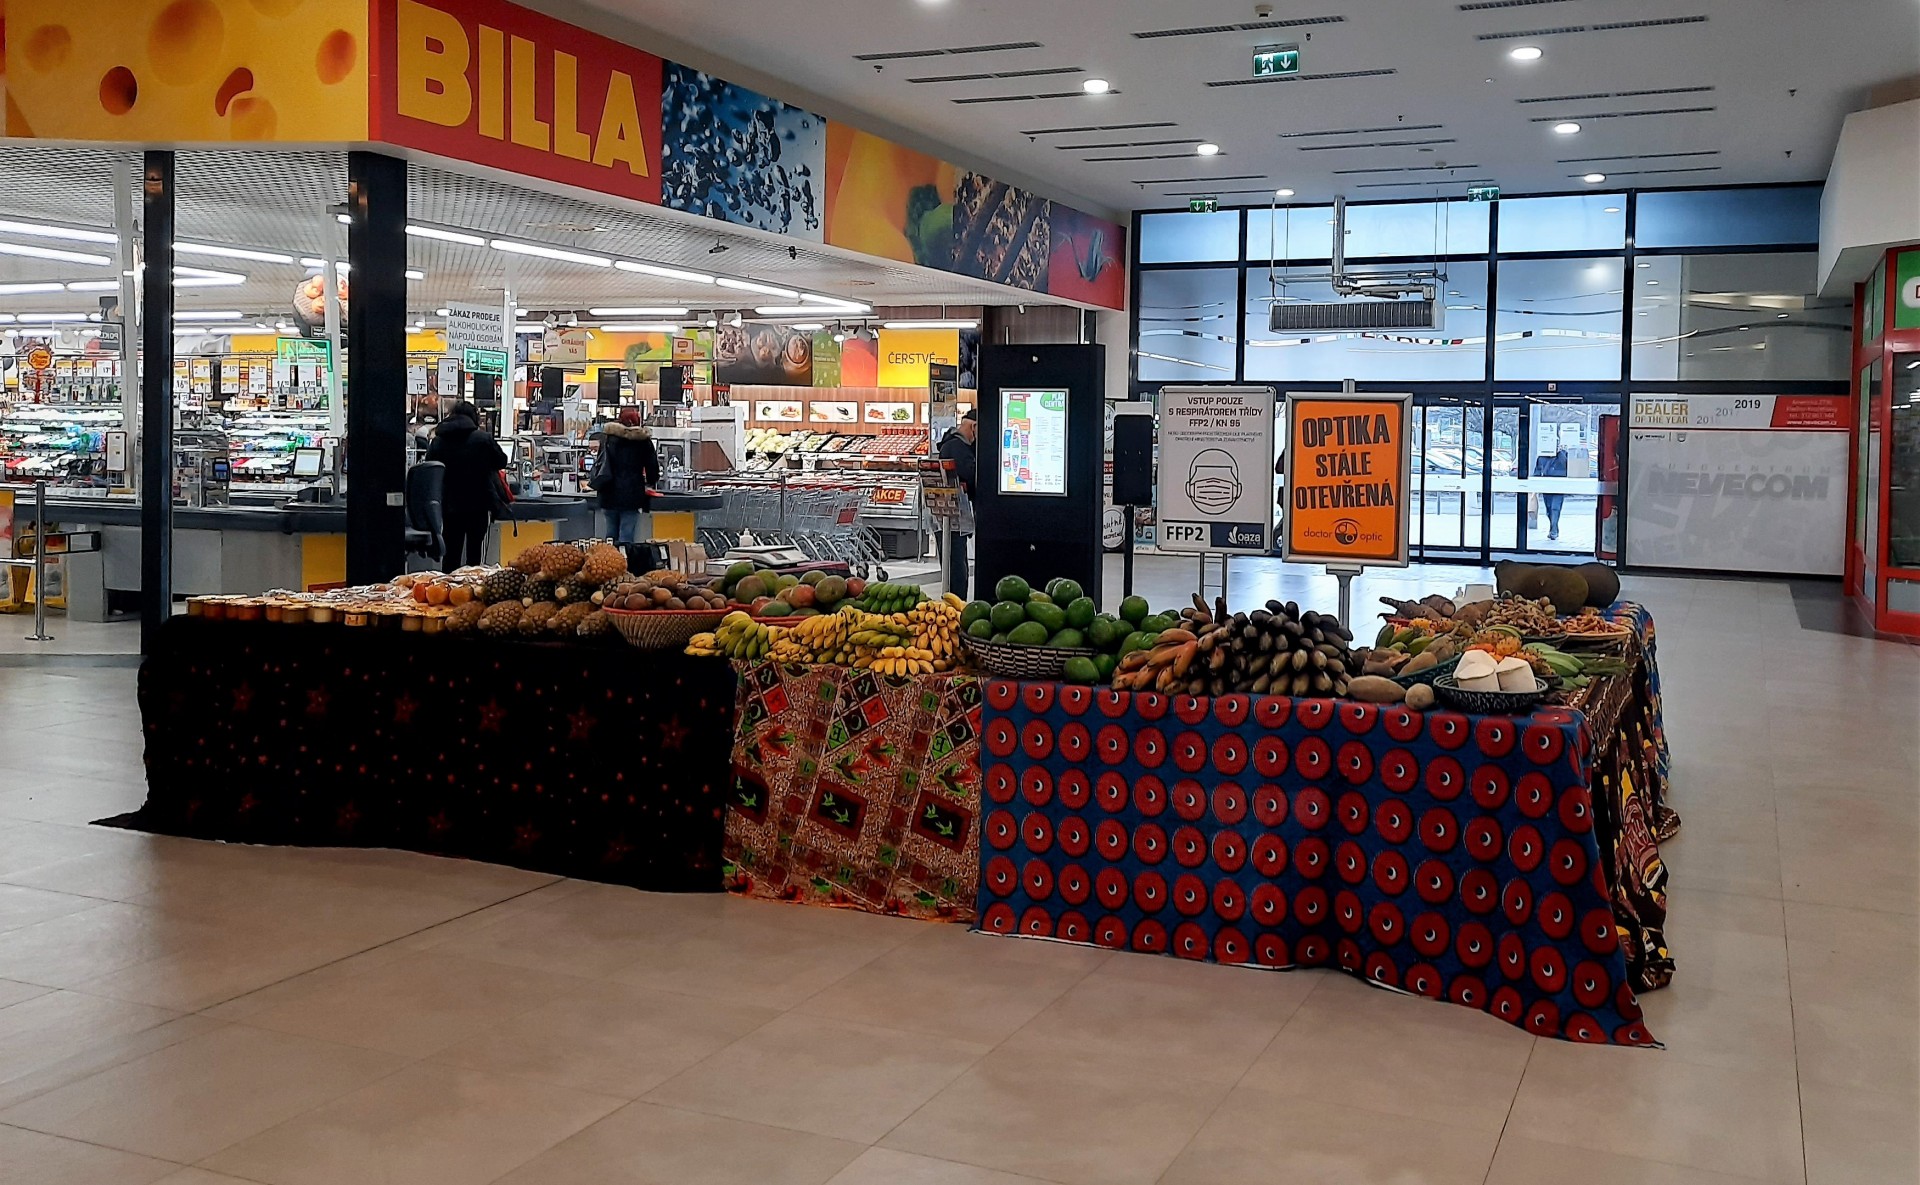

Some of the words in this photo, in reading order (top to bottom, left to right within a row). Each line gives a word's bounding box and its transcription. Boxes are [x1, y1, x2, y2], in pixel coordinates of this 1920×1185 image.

[398, 0, 649, 177] BILLA
[449, 308, 470, 318] ZÁKAZ
[471, 311, 500, 321] PRODEJE
[449, 320, 502, 333] ALKOHOLICKÝCH
[449, 331, 475, 341] NÁPOJŮ
[888, 351, 936, 365] ČERSTVÉ
[1187, 397, 1215, 405] VSTUP
[1216, 397, 1244, 405] POUZE
[1734, 399, 1761, 409] 2019
[1168, 408, 1174, 416] S
[1176, 405, 1237, 416] RESPIRÁTOREM
[1239, 406, 1263, 416] TŘÍDY
[1635, 402, 1689, 416] DEALER
[1189, 419, 1209, 427] FFP2
[1216, 419, 1228, 427] KN
[1635, 416, 1646, 424] OF
[1648, 416, 1664, 424] THE
[1666, 416, 1689, 425] YEAR
[1302, 414, 1390, 448] OPTIKA
[1315, 448, 1372, 478] STÁLE
[1648, 471, 1830, 499] NEVECOM
[873, 489, 902, 501] AKCE
[1295, 478, 1394, 510] OTEVŘENÁ
[1166, 525, 1204, 541] FFP2
[1237, 534, 1261, 543] oaza
[1303, 527, 1332, 538] doctor
[1360, 531, 1382, 543] optic
